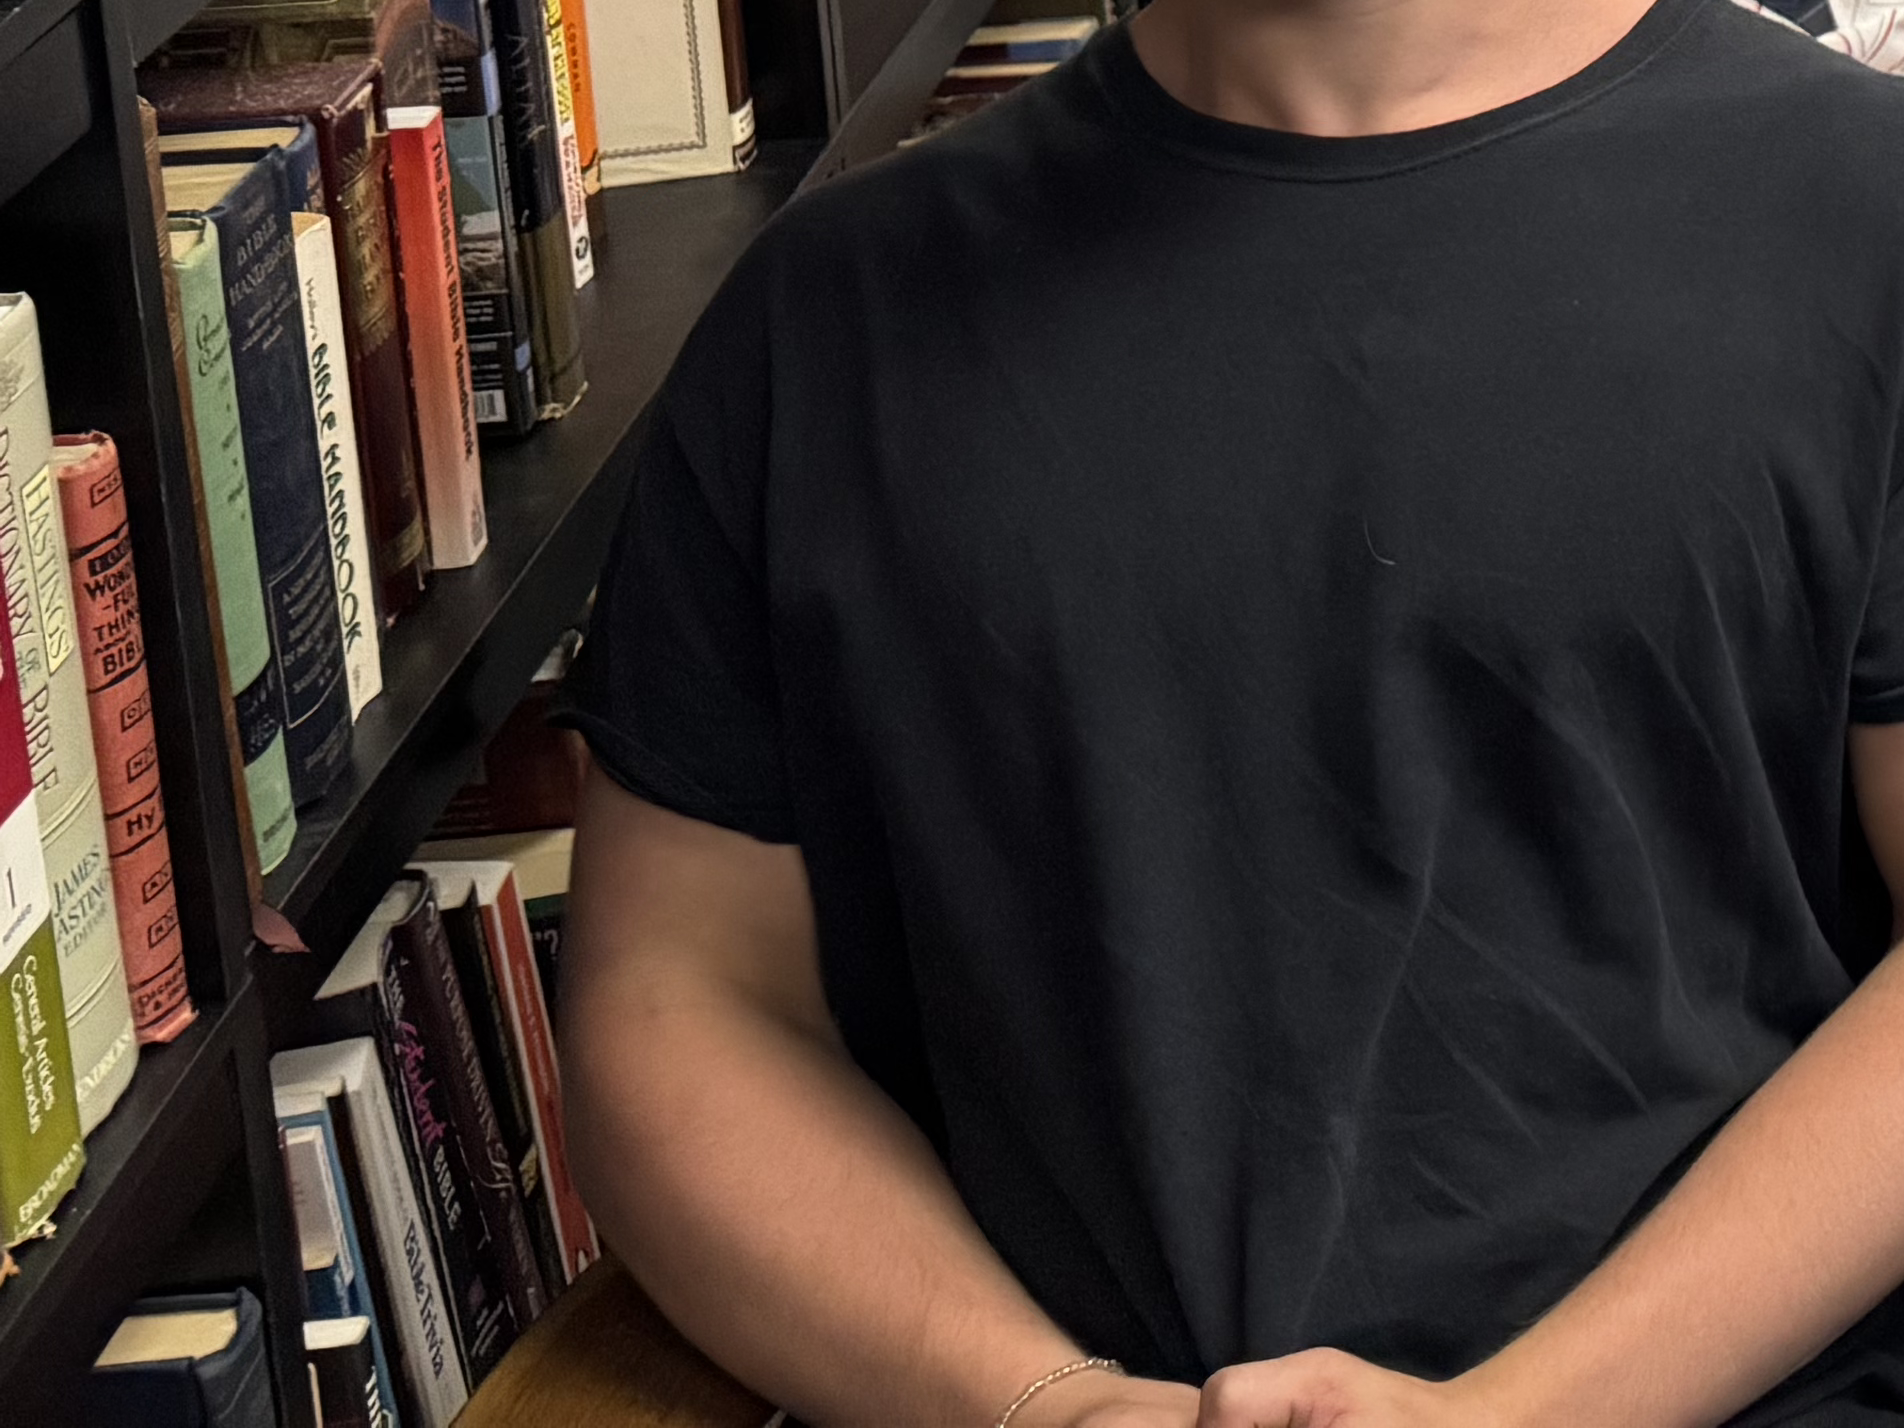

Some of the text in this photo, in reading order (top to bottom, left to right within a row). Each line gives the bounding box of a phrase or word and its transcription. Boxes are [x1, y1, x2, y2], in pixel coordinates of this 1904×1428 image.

[229, 233, 294, 307] HANDBOOK
[237, 213, 277, 266] BIBLE
[432, 139, 474, 462] The Student Bible Handbook
[24, 472, 70, 661] HASTINGS
[311, 342, 362, 655] BIBLE HANDBOOK
[23, 955, 55, 1111] General Articles
[399, 1020, 448, 1144] Student
[432, 1144, 462, 1231] BIBLE
[403, 1217, 444, 1381] Bible Trivia
